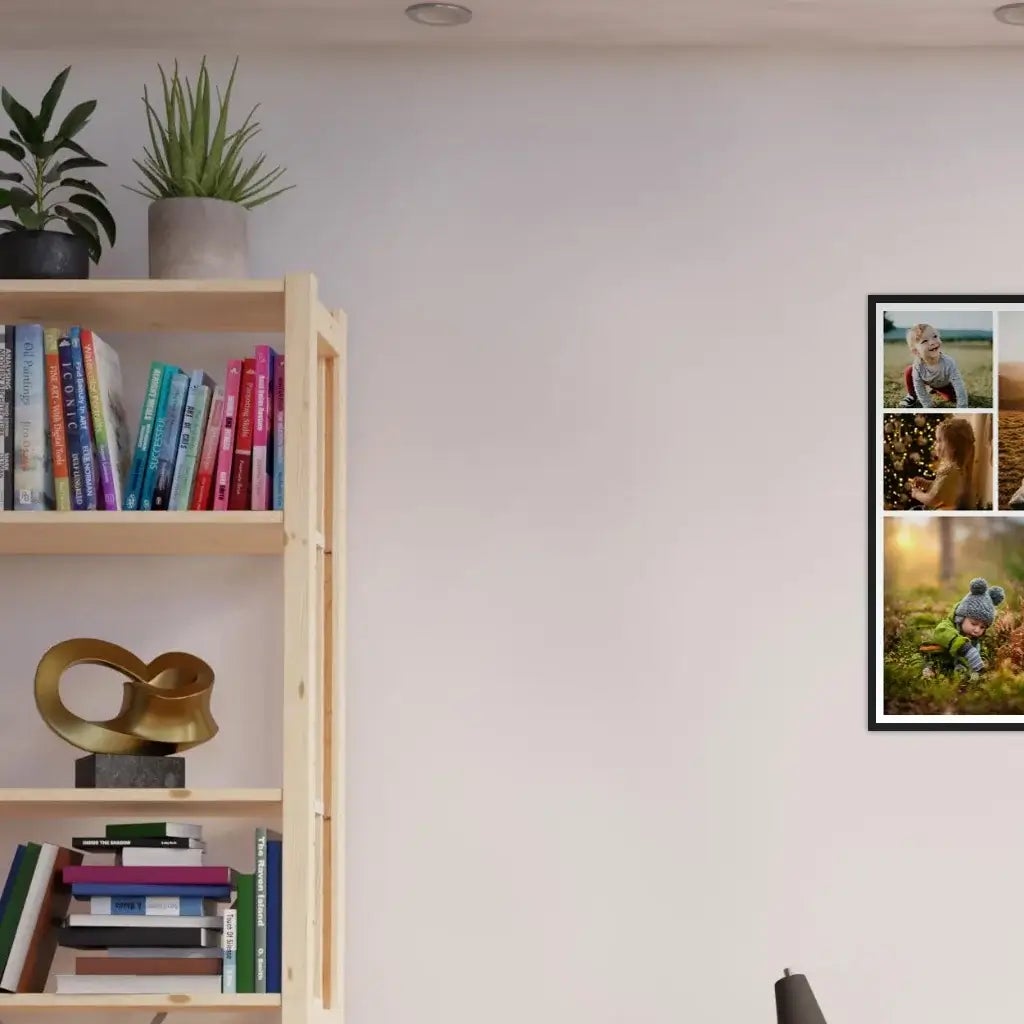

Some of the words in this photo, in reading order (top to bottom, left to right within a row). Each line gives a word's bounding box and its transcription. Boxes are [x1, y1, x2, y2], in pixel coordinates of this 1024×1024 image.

[23, 342, 35, 357] Oil
[20, 360, 34, 406] Paintings
[62, 363, 78, 429] ICONIC
[258, 836, 266, 857] The
[257, 859, 265, 892] Raven
[225, 913, 234, 930] Touch
[257, 894, 265, 927] Island
